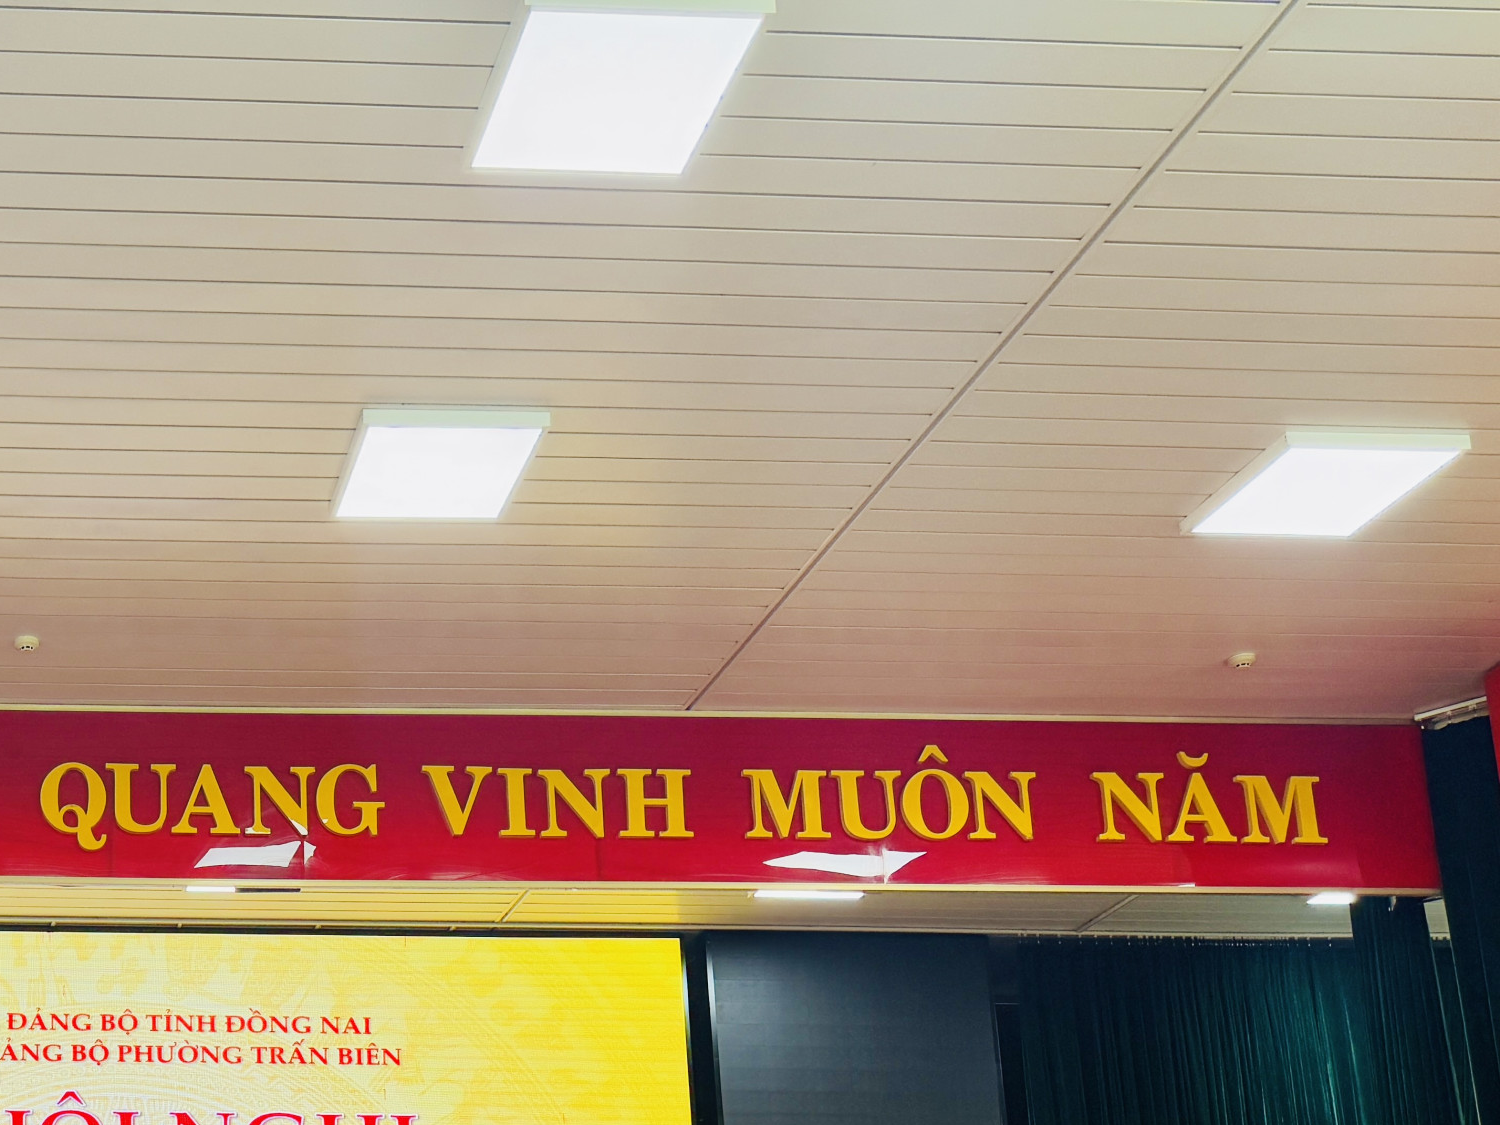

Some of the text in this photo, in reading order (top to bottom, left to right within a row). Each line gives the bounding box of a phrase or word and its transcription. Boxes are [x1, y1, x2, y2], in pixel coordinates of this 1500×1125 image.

[40, 761, 385, 851] QUANG
[421, 765, 695, 838] VINH
[742, 744, 1036, 841] MUÔN
[1092, 750, 1329, 845] NĂM
[6, 1007, 372, 1035] ĐẢNG BỘ TỈNH ĐỒNG NAI
[71, 1038, 110, 1066] BỘ
[117, 1040, 242, 1064] PHƯỜNG
[250, 1038, 329, 1066] TRẤN
[337, 1043, 402, 1066] BIÊN
